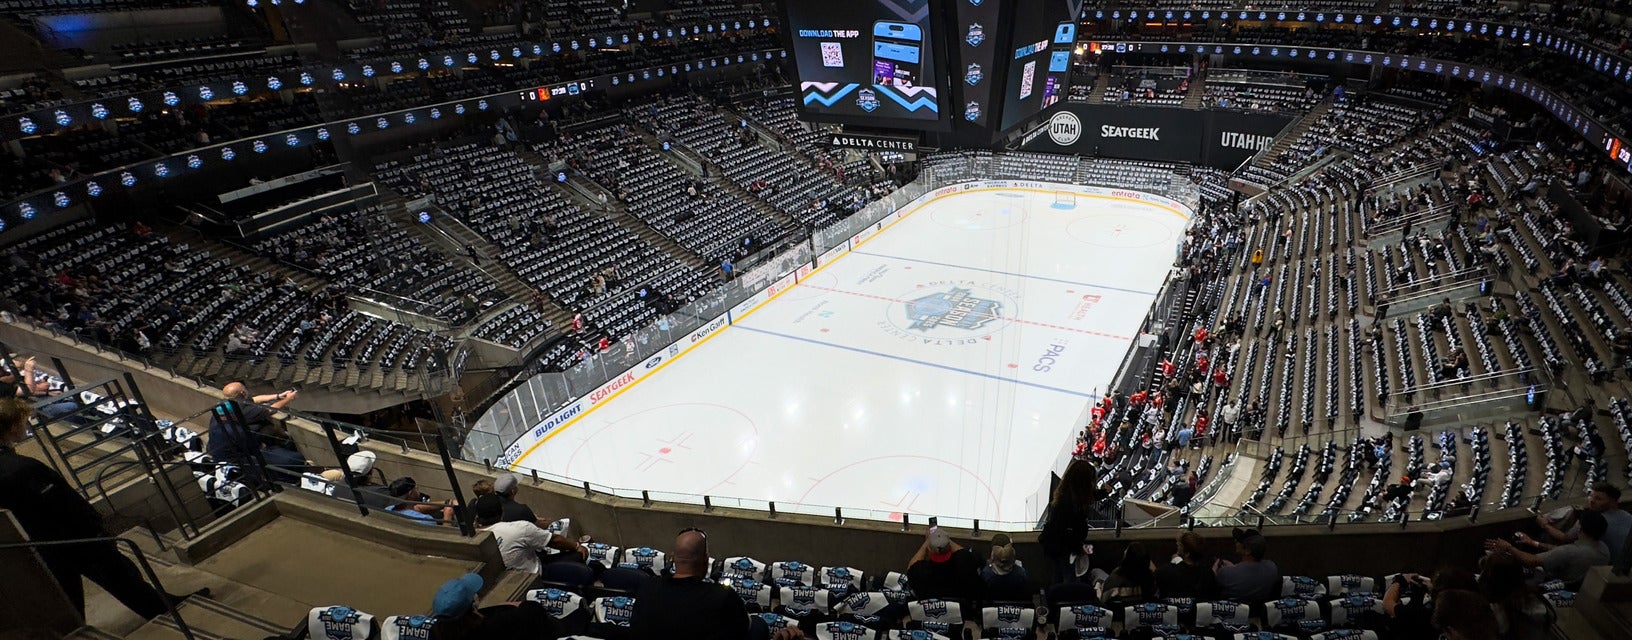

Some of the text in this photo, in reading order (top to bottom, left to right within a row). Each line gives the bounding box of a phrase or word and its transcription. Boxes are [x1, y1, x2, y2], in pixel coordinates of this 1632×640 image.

[799, 30, 859, 38] DOWNLOAD THE APP
[1054, 123, 1076, 135] UTAH
[1101, 125, 1160, 140] SEATGEEK
[842, 137, 913, 150] DELTA CENTER
[1221, 132, 1255, 150] UTAH
[935, 187, 957, 197] entrata
[1112, 190, 1140, 199] entrata
[697, 318, 725, 339] Ken Garff
[1033, 344, 1065, 373] PACS
[589, 372, 635, 405] SEATGEEK
[535, 404, 581, 438] BUD LIGHT
[924, 601, 946, 610] GAME
[326, 621, 351, 631] GAME
[400, 626, 426, 639] GAME
